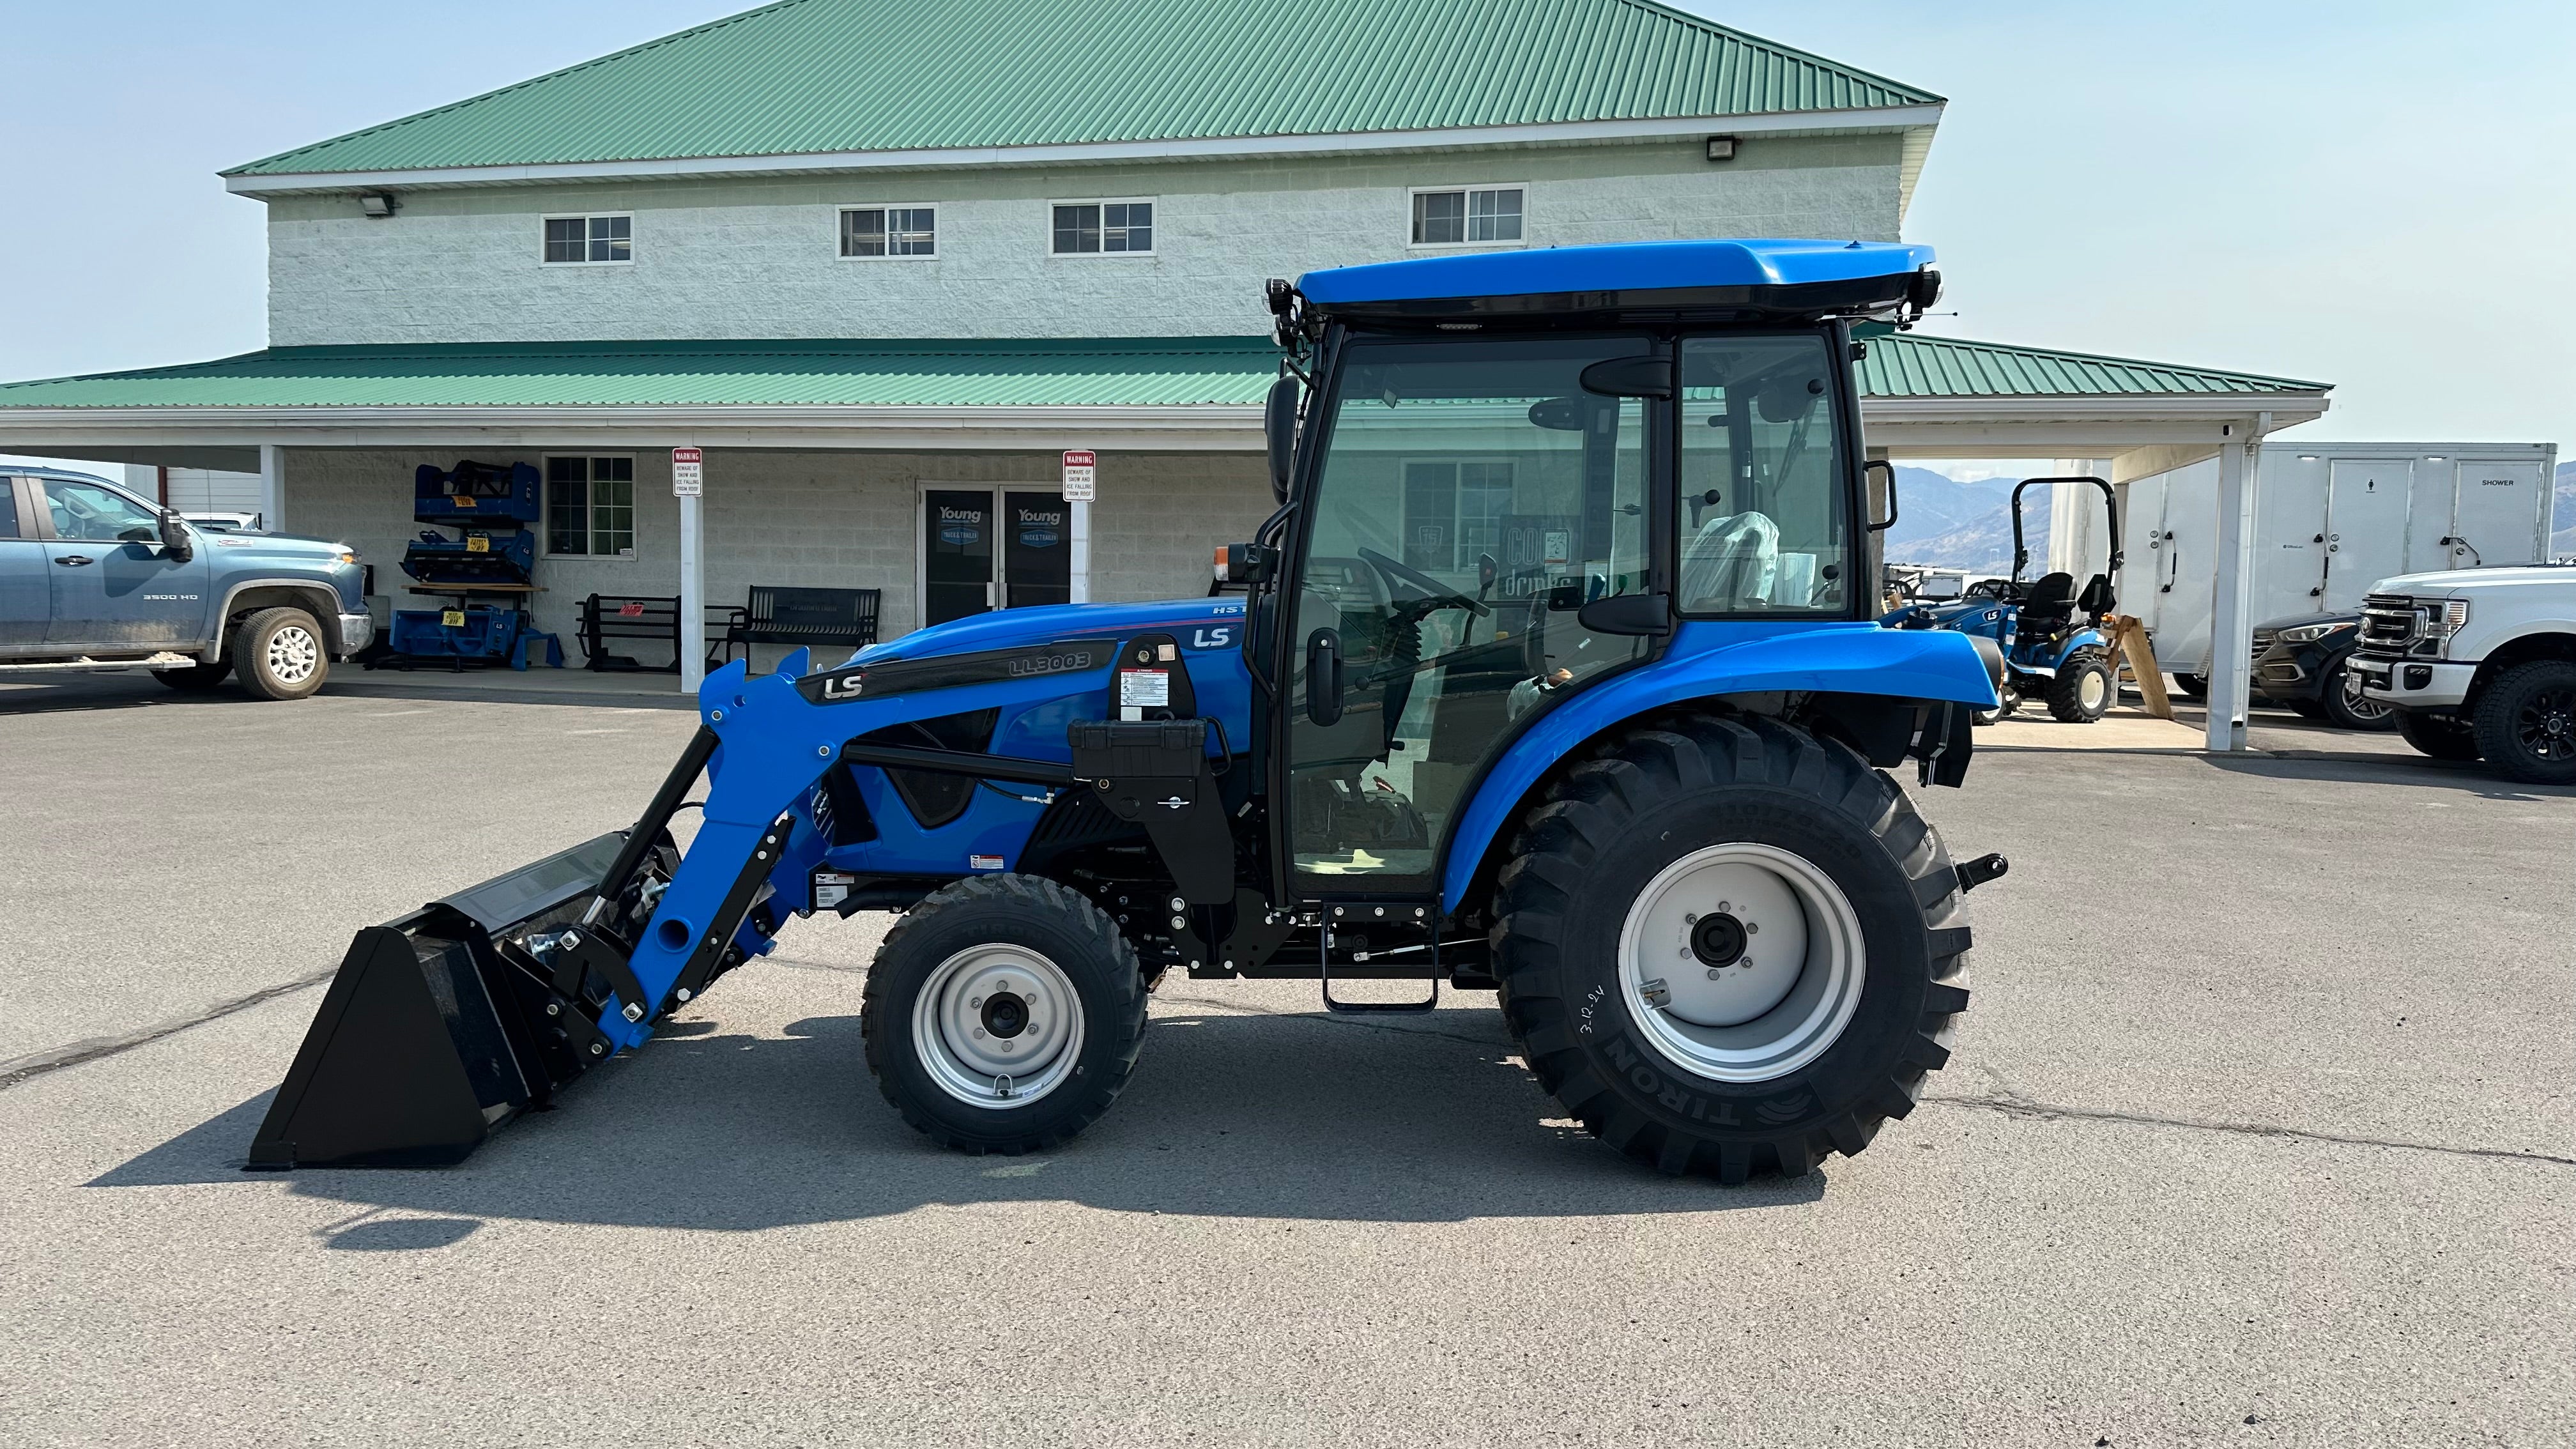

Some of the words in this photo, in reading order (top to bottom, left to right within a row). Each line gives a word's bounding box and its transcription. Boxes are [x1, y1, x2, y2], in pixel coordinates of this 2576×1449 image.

[1066, 456, 1092, 464] WARNING
[940, 507, 981, 523] Young
[1018, 509, 1061, 525] Young
[1988, 611, 1997, 620] LS
[1194, 628, 1229, 647] LS
[1009, 652, 1091, 676] LL3003
[824, 676, 862, 700] LS
[1604, 1037, 1741, 1126] TIRON
